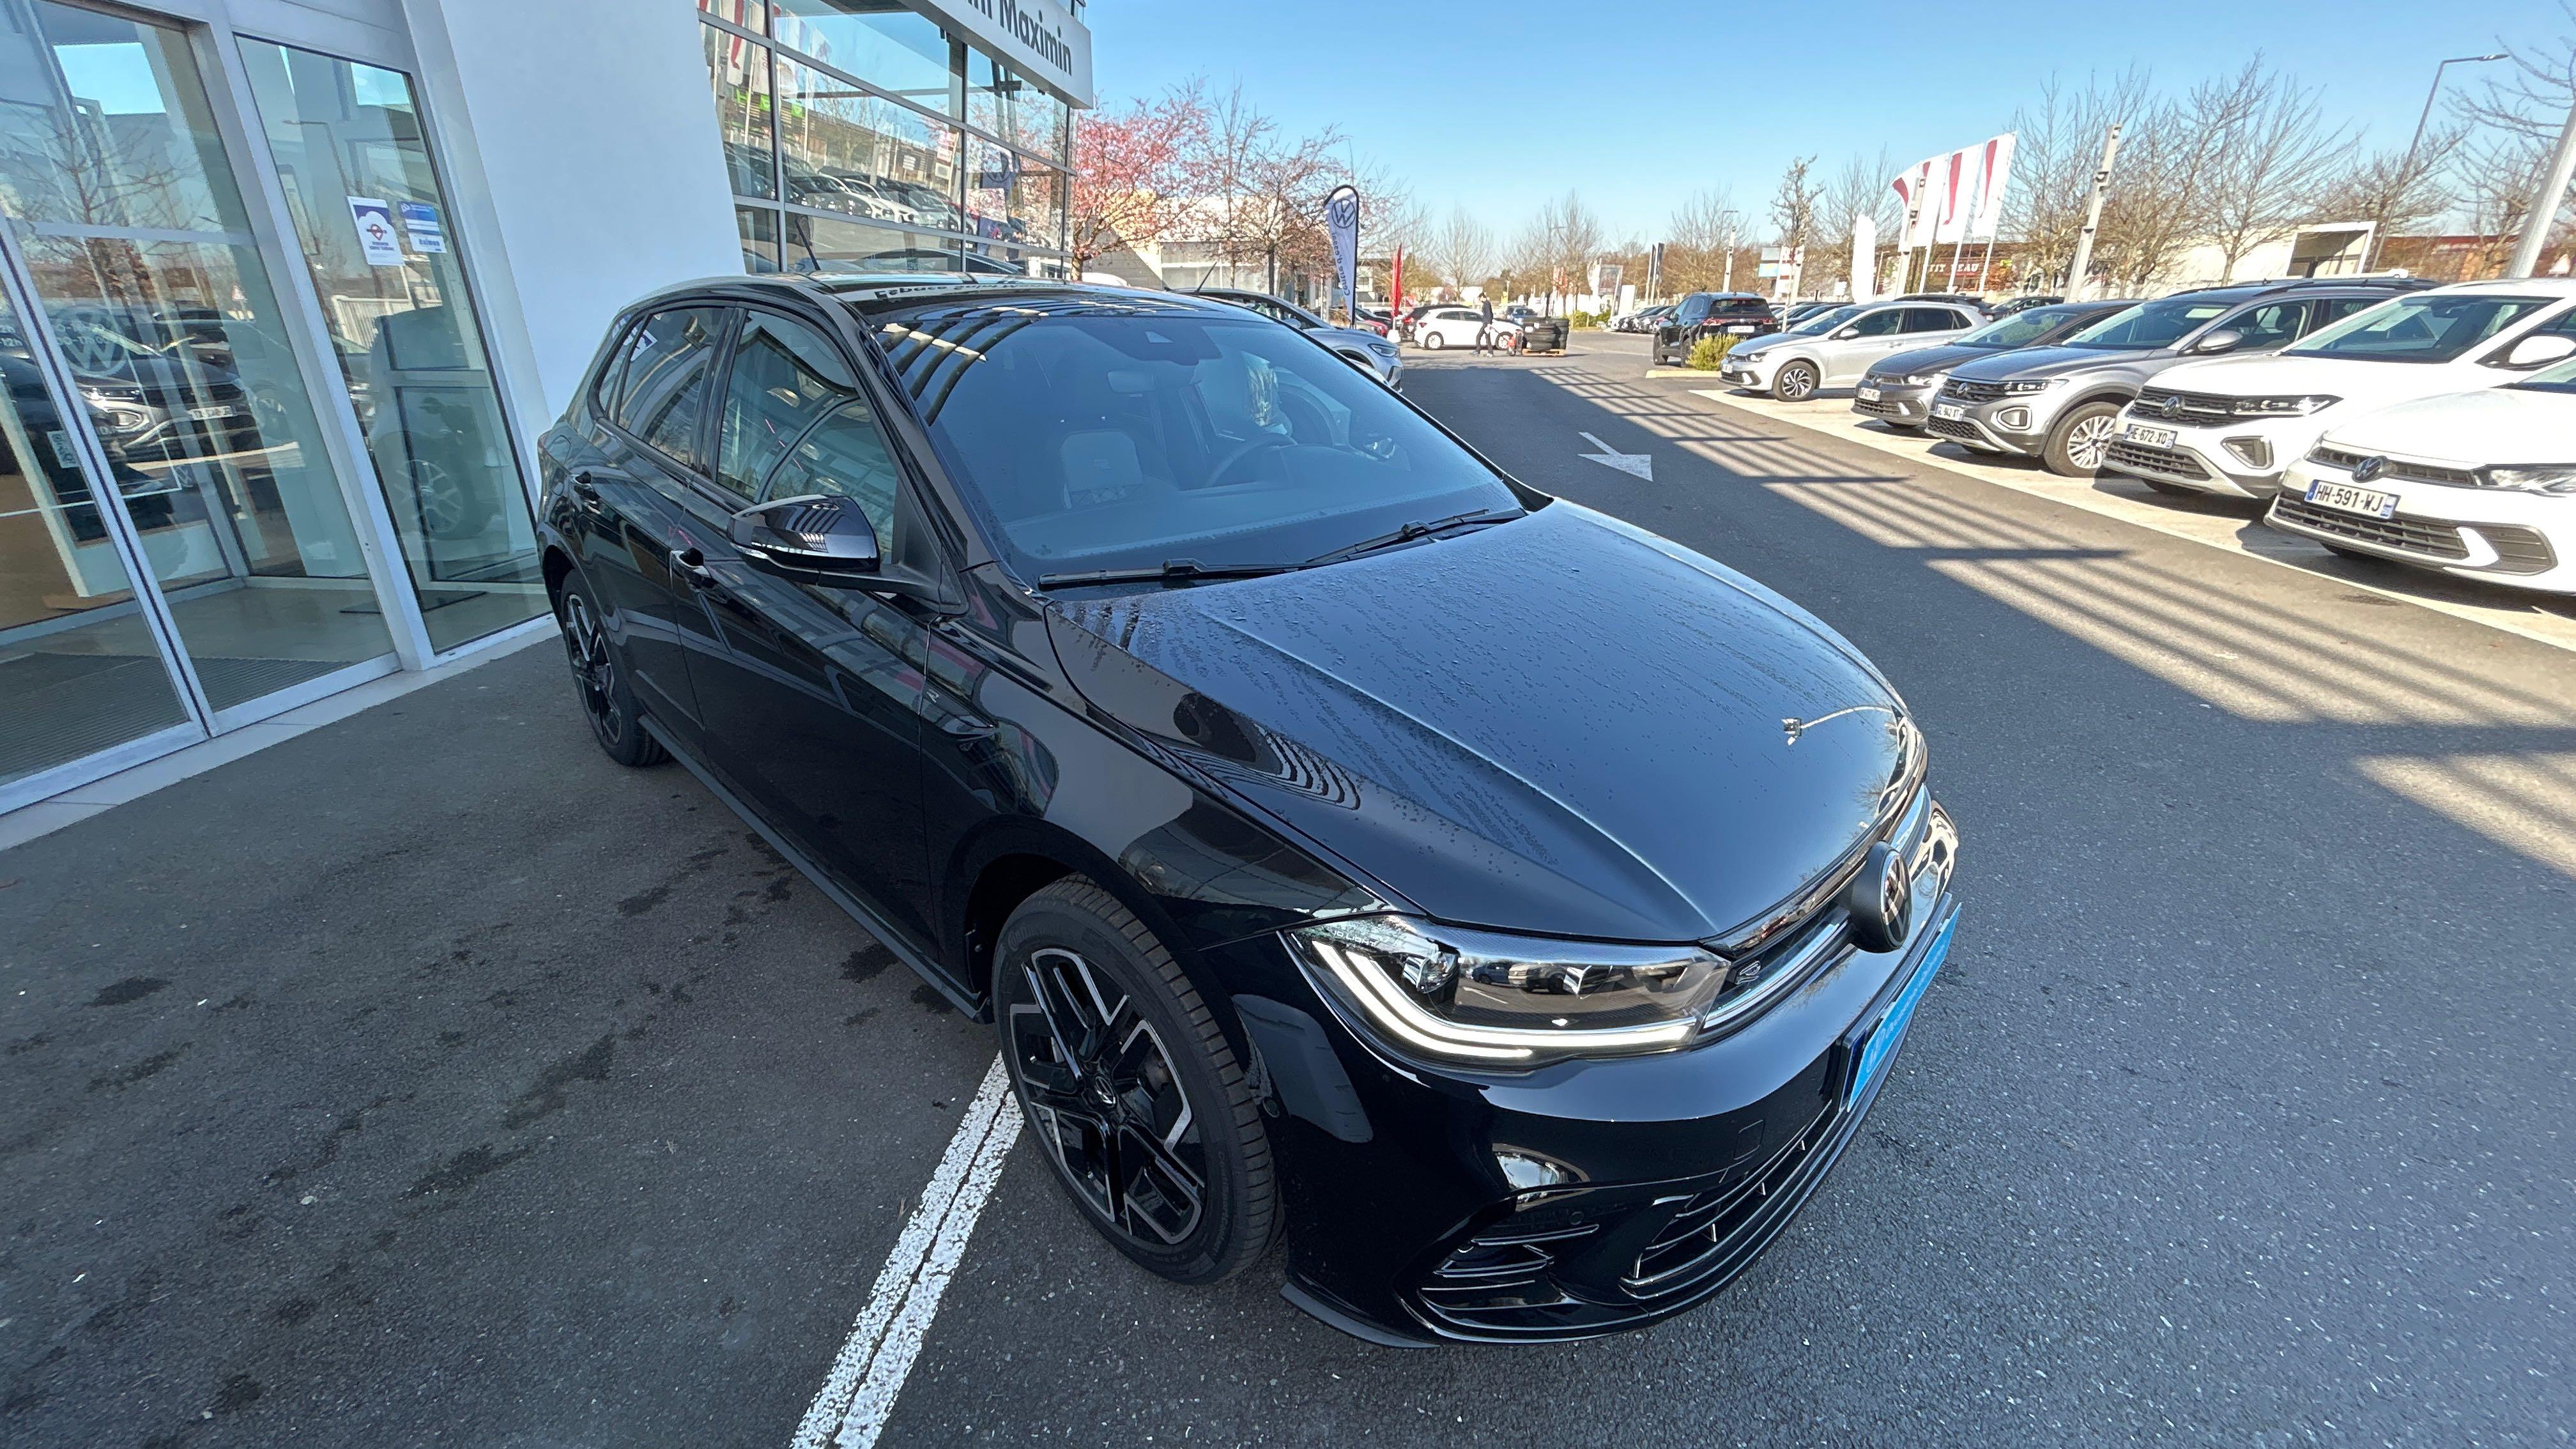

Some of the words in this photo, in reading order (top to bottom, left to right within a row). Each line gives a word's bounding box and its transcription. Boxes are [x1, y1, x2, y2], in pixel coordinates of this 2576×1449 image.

[999, 0, 1072, 76] Maximin
[1951, 263, 1980, 273] EAU
[2314, 484, 2384, 512] HH-591-WJ
